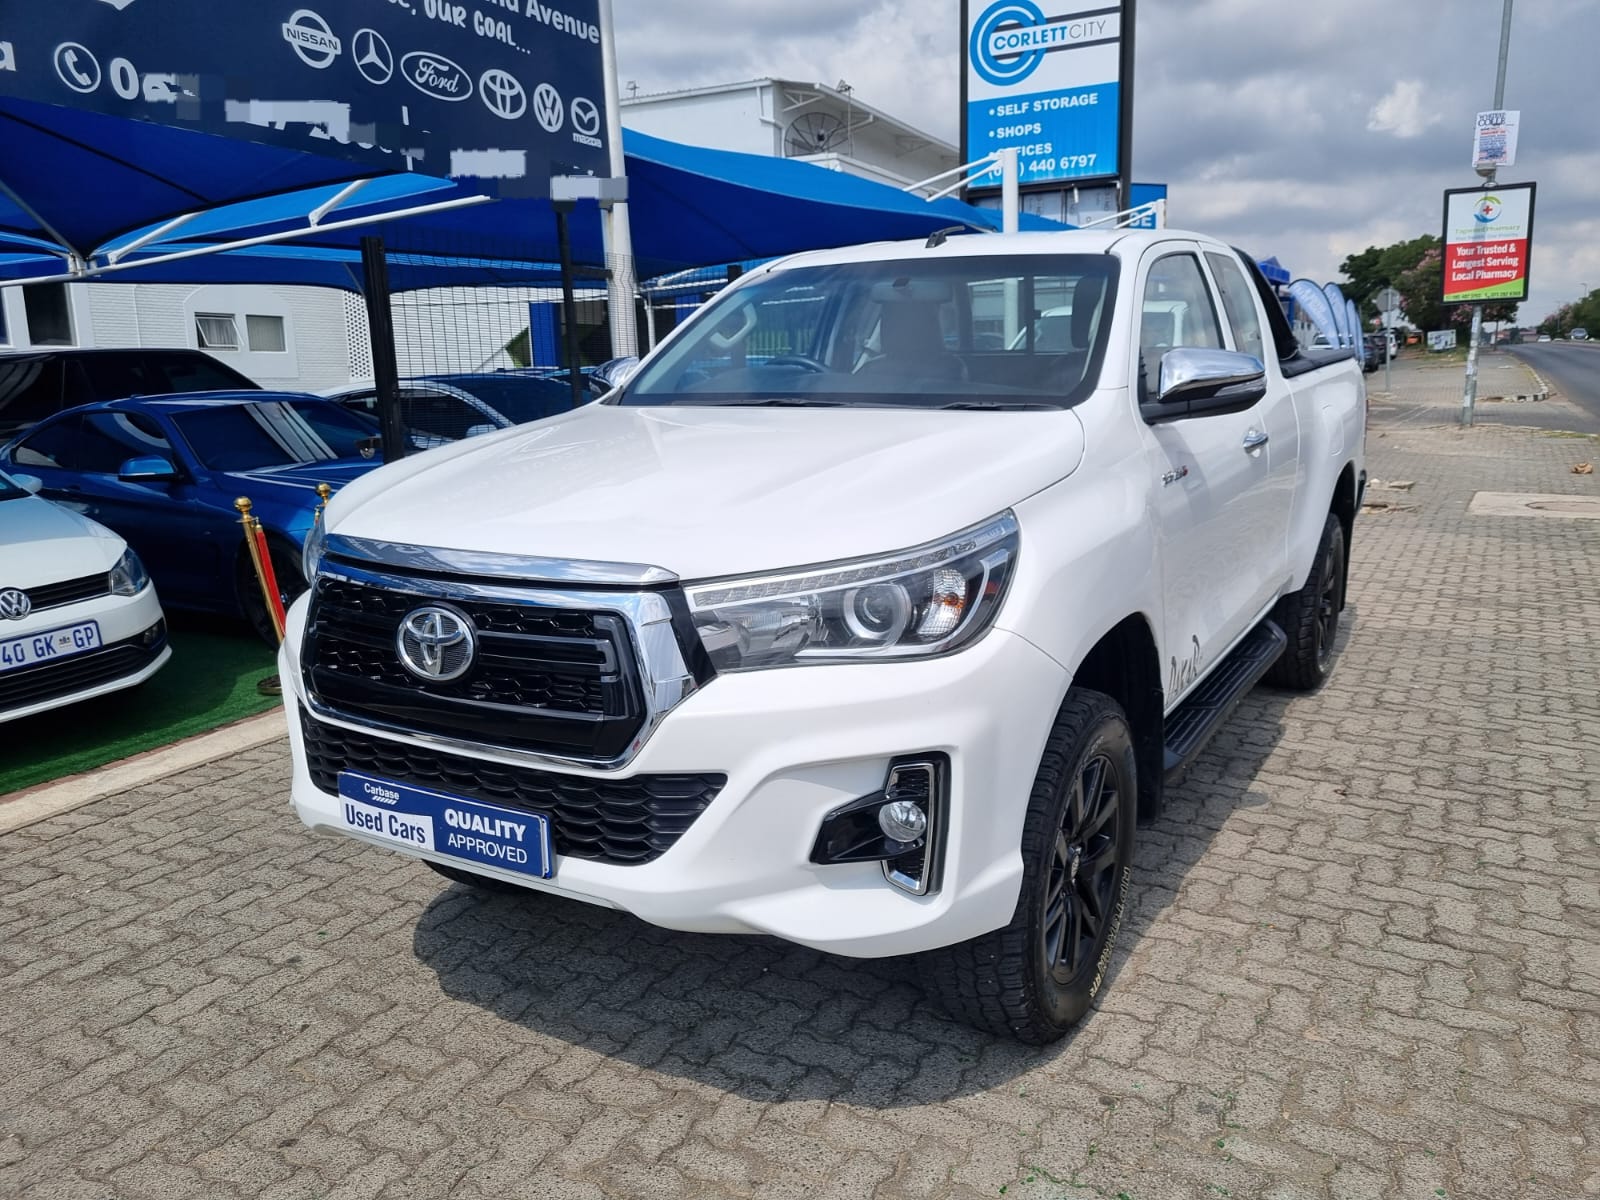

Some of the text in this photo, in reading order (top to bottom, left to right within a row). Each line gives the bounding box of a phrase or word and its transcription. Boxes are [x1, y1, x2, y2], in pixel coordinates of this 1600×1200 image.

[424, 0, 467, 28] OUR
[526, 0, 600, 44] Avenue
[286, 27, 338, 50] NISSAN
[415, 58, 460, 93] Ford
[996, 93, 1099, 117] SELF STORAGE
[996, 123, 1042, 139] SHOPS
[1028, 158, 1056, 172] 440
[1060, 153, 1097, 169] 6797
[1456, 243, 1516, 256] Your Trusted &
[1452, 256, 1519, 270] Longest Serving
[1452, 269, 1518, 281] Local Pharmacy
[2, 626, 94, 665] 40 GK GP
[364, 783, 400, 800] Carbase
[345, 803, 426, 844] Used Cars
[444, 808, 527, 842] QUALITY
[448, 833, 528, 864] APPROVED
